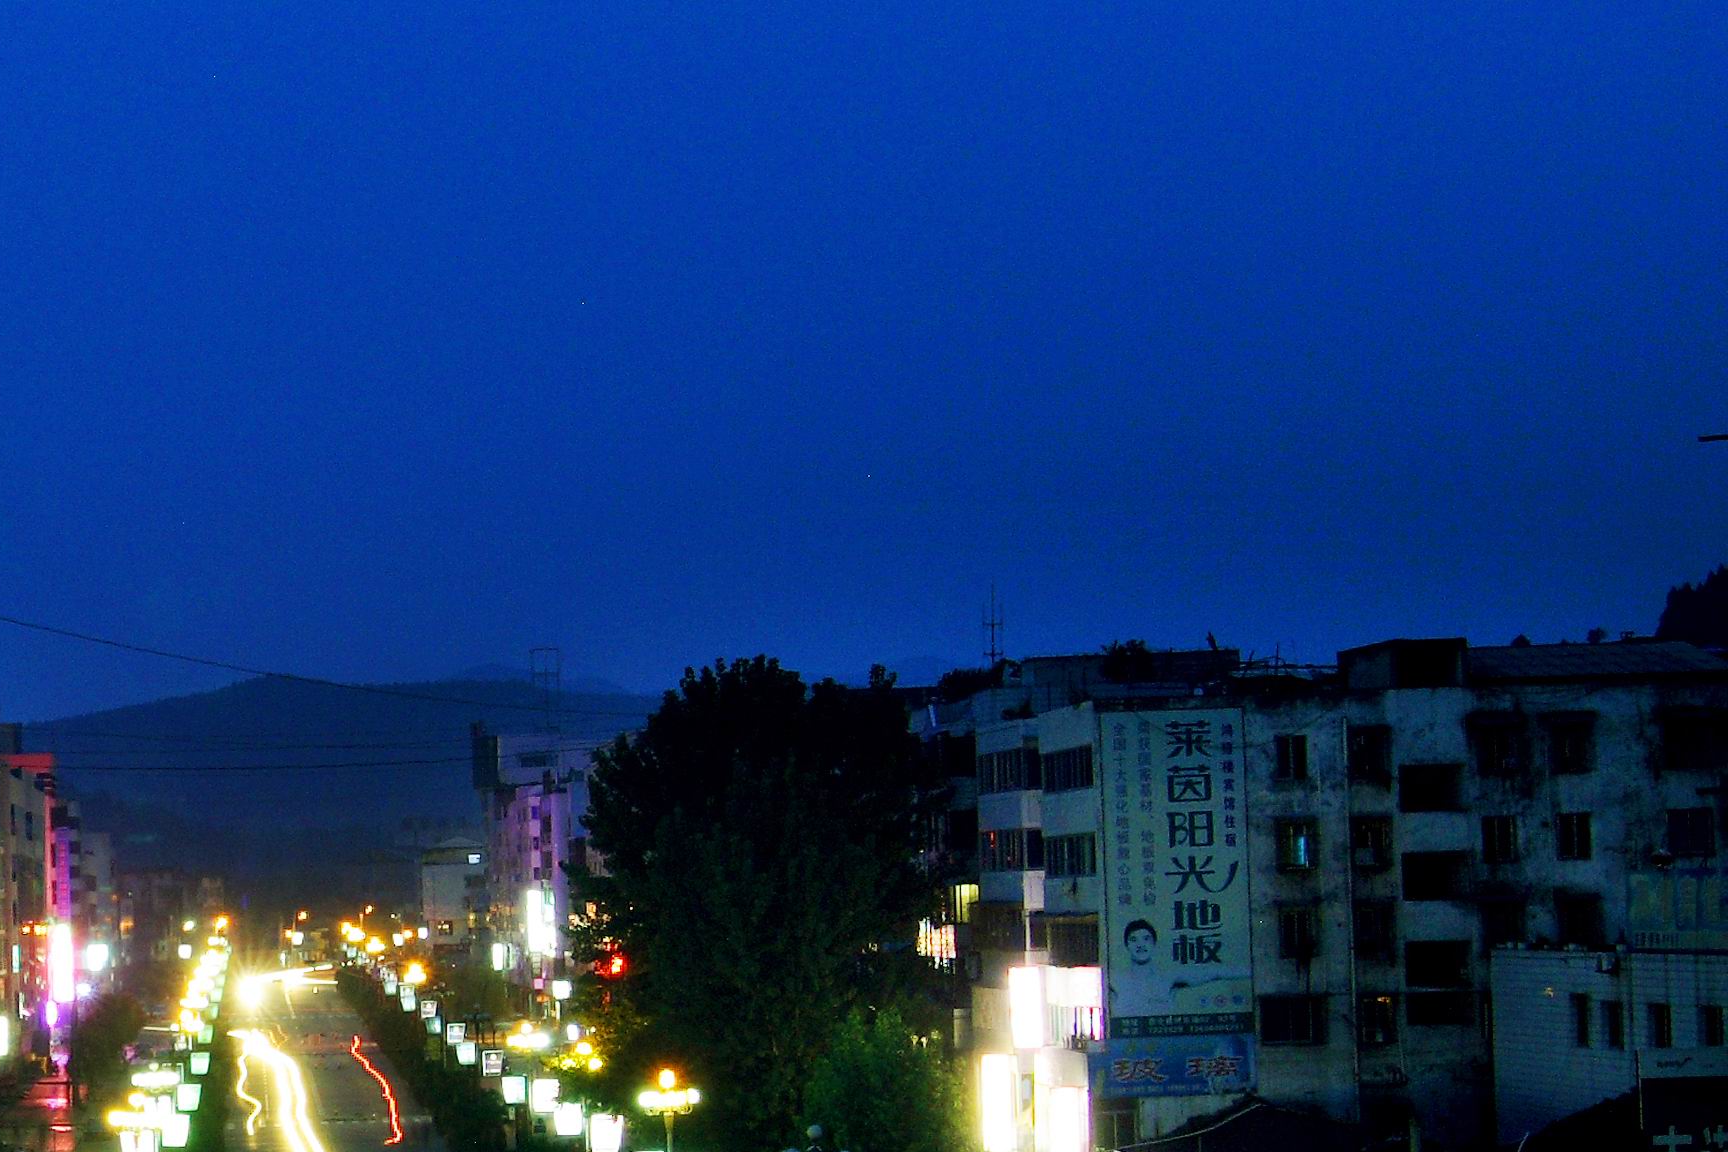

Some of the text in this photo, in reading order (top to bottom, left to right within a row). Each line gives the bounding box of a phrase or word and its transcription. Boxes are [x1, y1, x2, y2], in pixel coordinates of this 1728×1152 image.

[1165, 720, 1238, 964] 莱茵阳光地板
